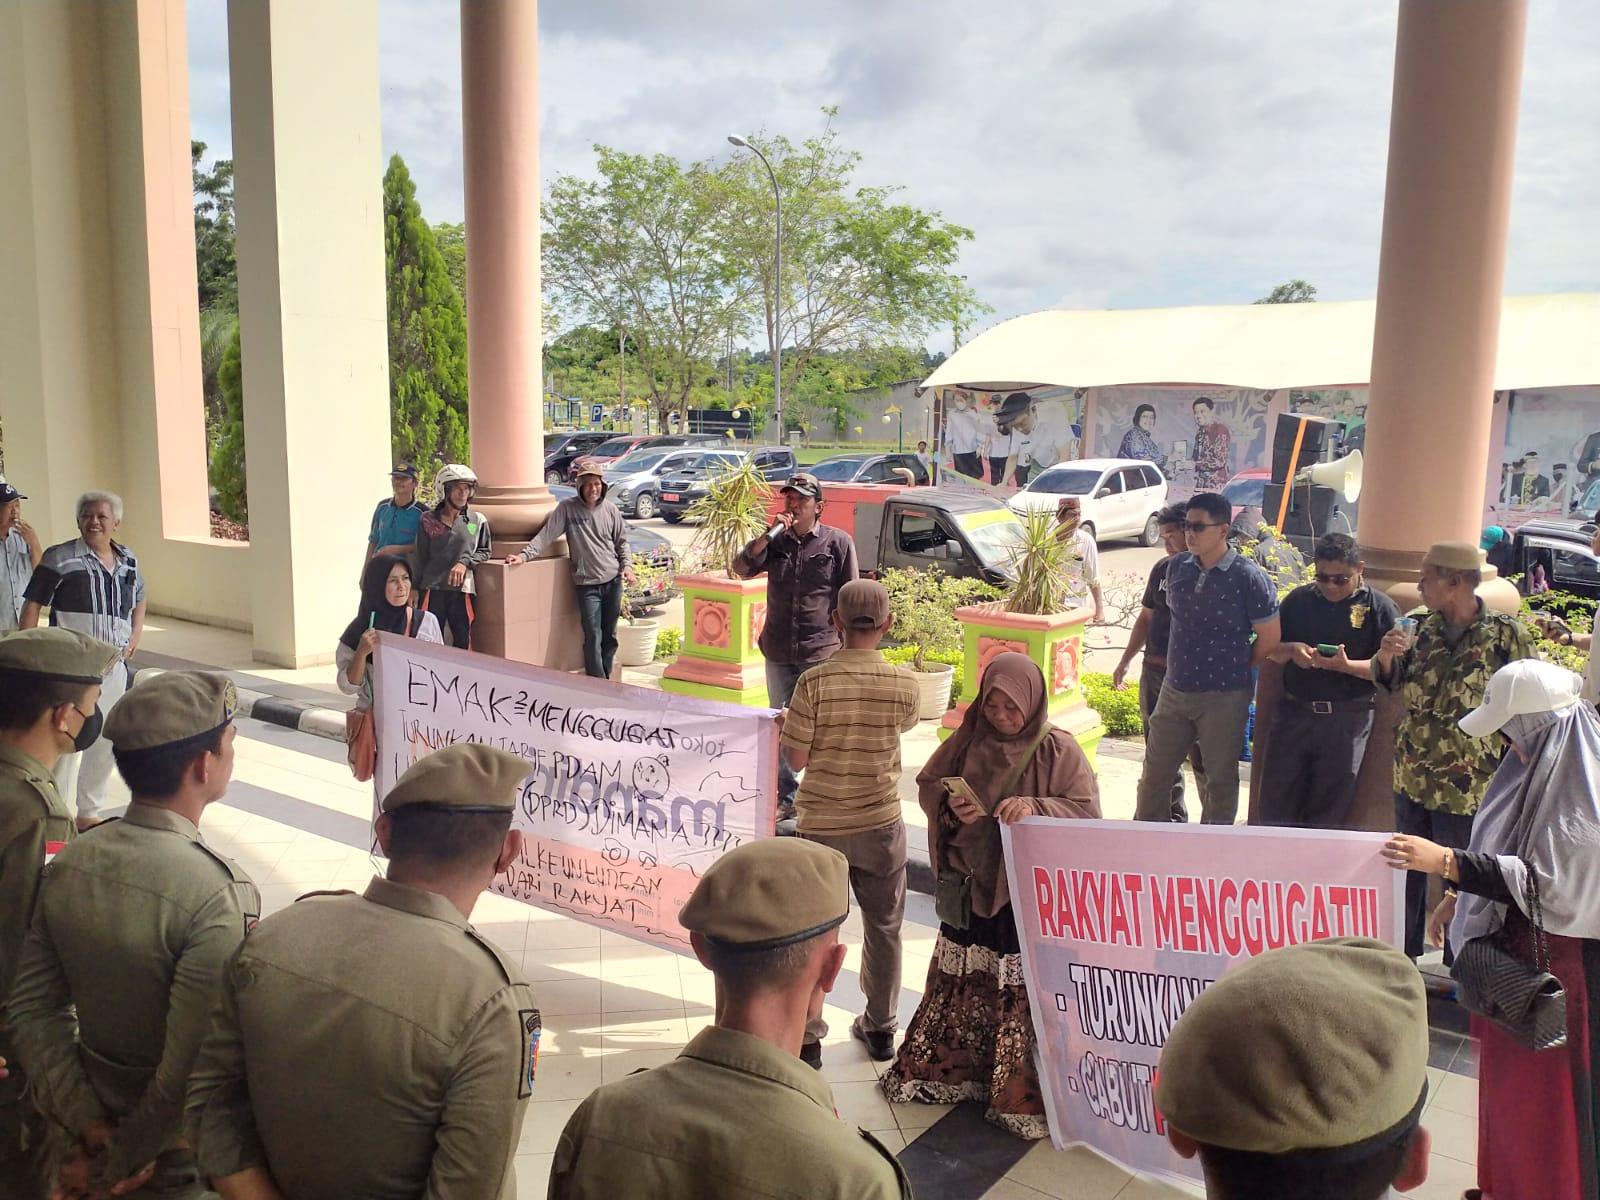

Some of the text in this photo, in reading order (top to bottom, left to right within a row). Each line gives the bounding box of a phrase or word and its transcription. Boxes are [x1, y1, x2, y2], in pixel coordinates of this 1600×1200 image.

[528, 699, 681, 749] MENGGUGAT
[553, 752, 621, 792] PDAM
[1033, 867, 1143, 948] RAKYAT
[1079, 1051, 1151, 1133] CABUT
